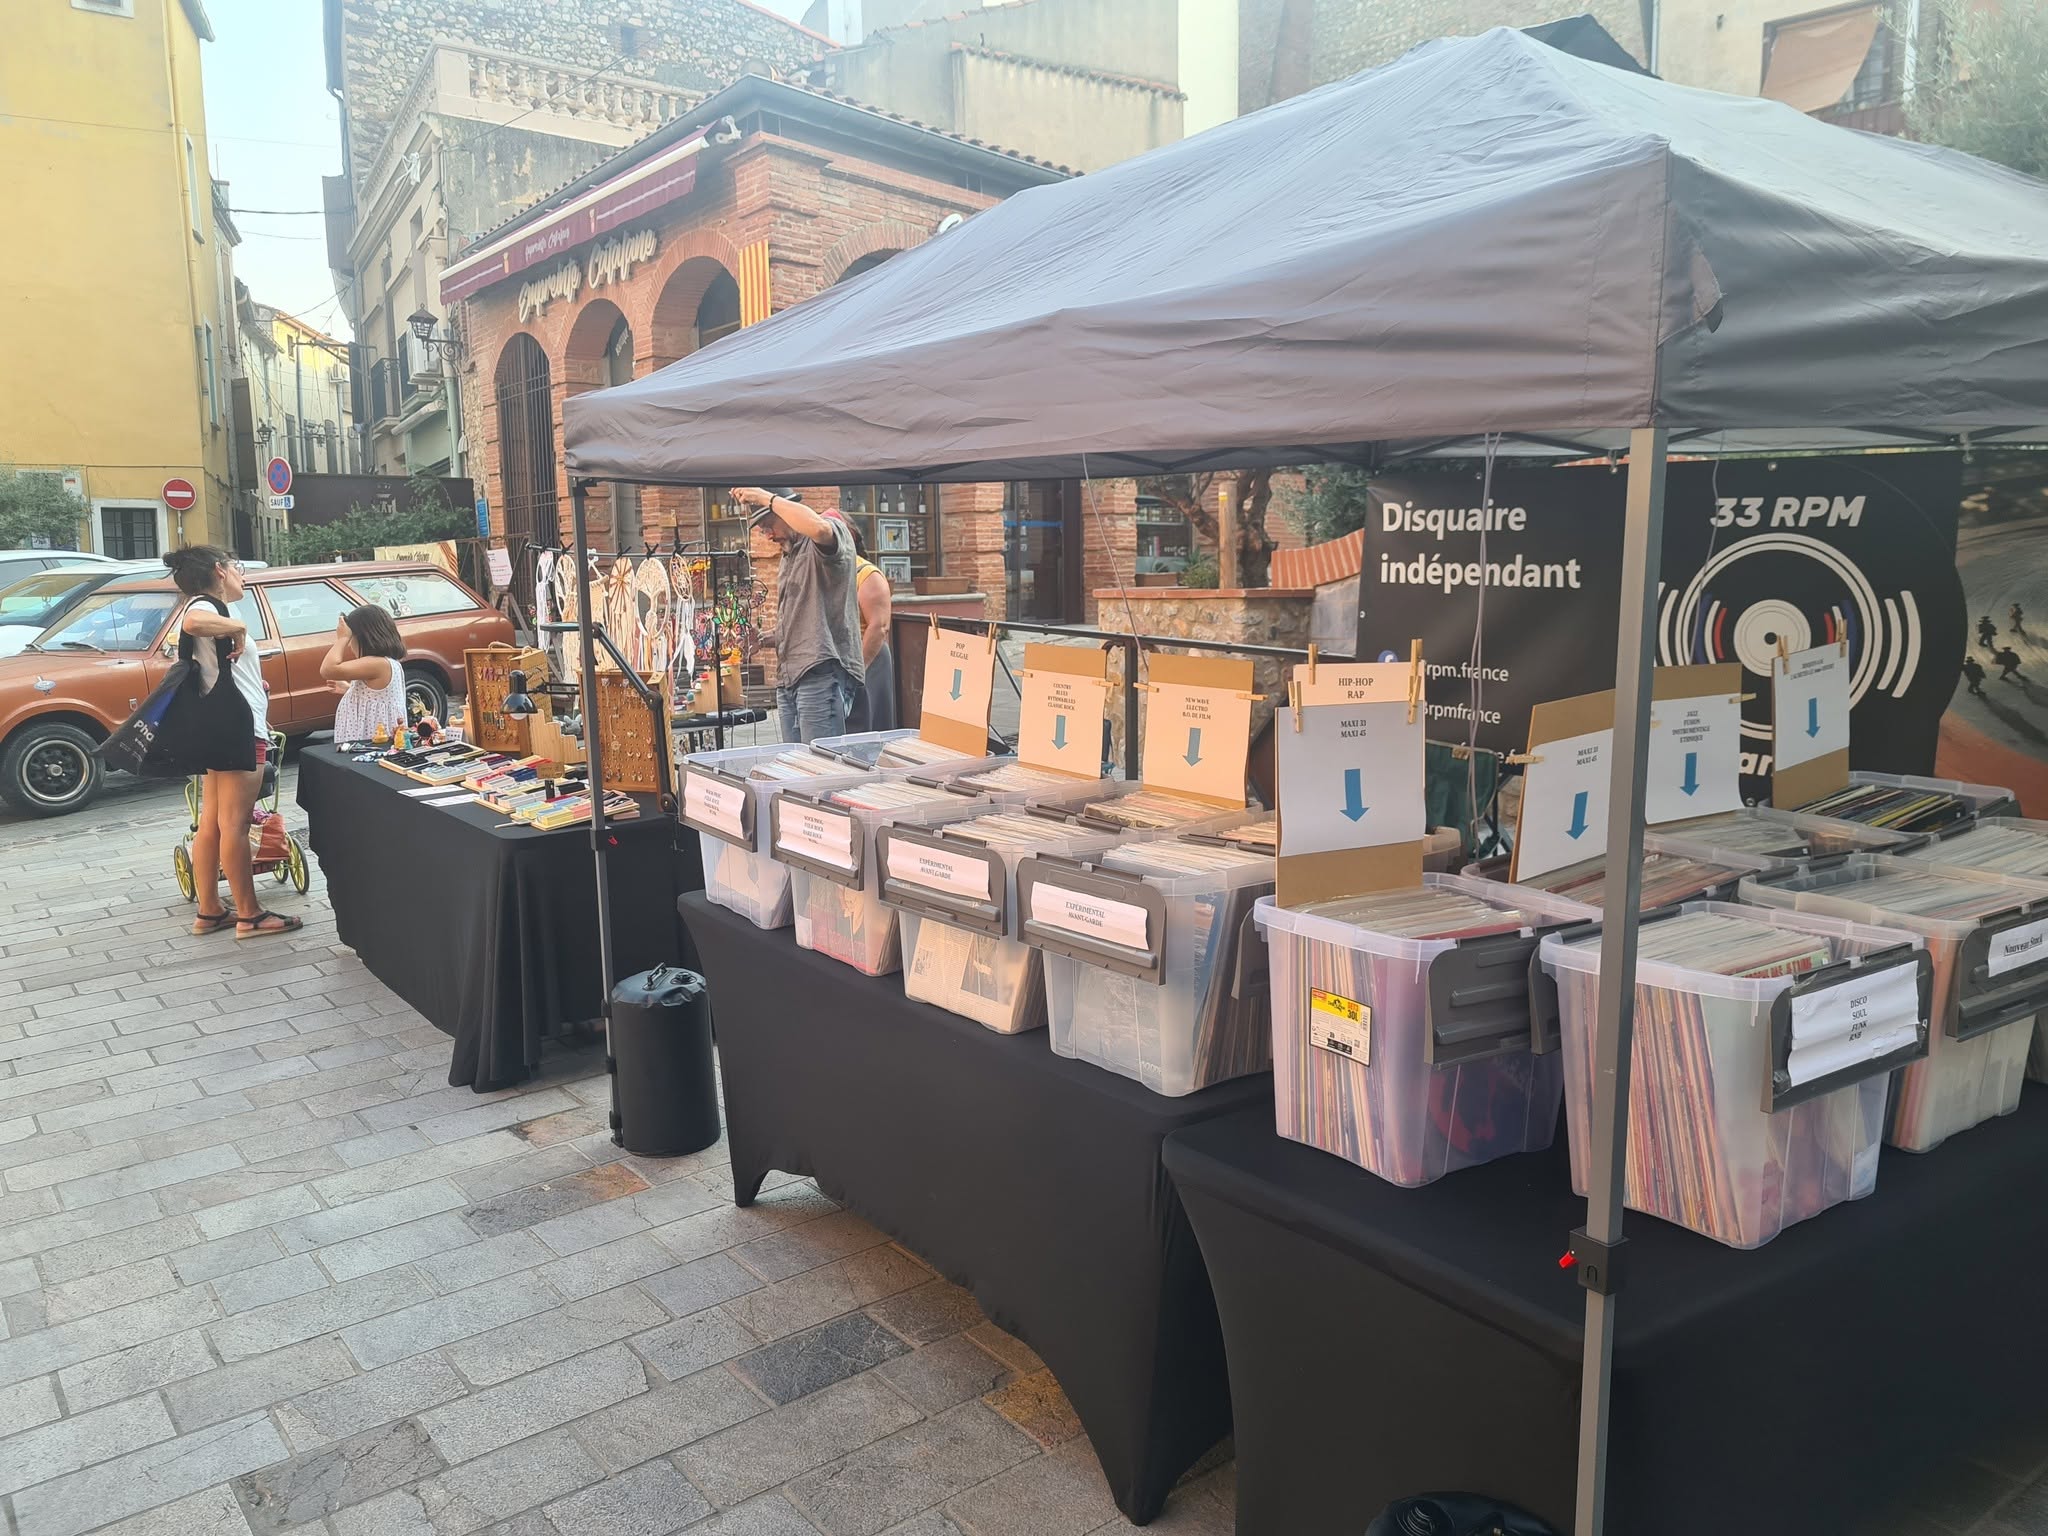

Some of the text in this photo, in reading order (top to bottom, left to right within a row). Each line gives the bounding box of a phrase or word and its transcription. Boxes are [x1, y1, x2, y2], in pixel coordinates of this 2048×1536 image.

[588, 228, 658, 290] Catalane
[270, 497, 284, 507] SAUF
[1709, 495, 1867, 528] 33 RPM
[1382, 498, 1527, 540] Disquaire
[1380, 552, 1581, 594] indépendant
[955, 642, 966, 650] POP
[950, 650, 969, 660] REGGAE
[1422, 661, 1509, 682] rpm.france
[1338, 677, 1374, 687] HIP-HOP
[1347, 690, 1365, 699] RAP
[1186, 704, 1209, 712] ELECTRO
[1340, 719, 1367, 728] MAXI 33
[1340, 729, 1367, 738] MAXI 45
[1850, 995, 1868, 1009] DISCO
[1347, 1009, 1359, 1022] 30L
[1852, 1008, 1868, 1020] SOUL
[1851, 1020, 1868, 1032] FUNK
